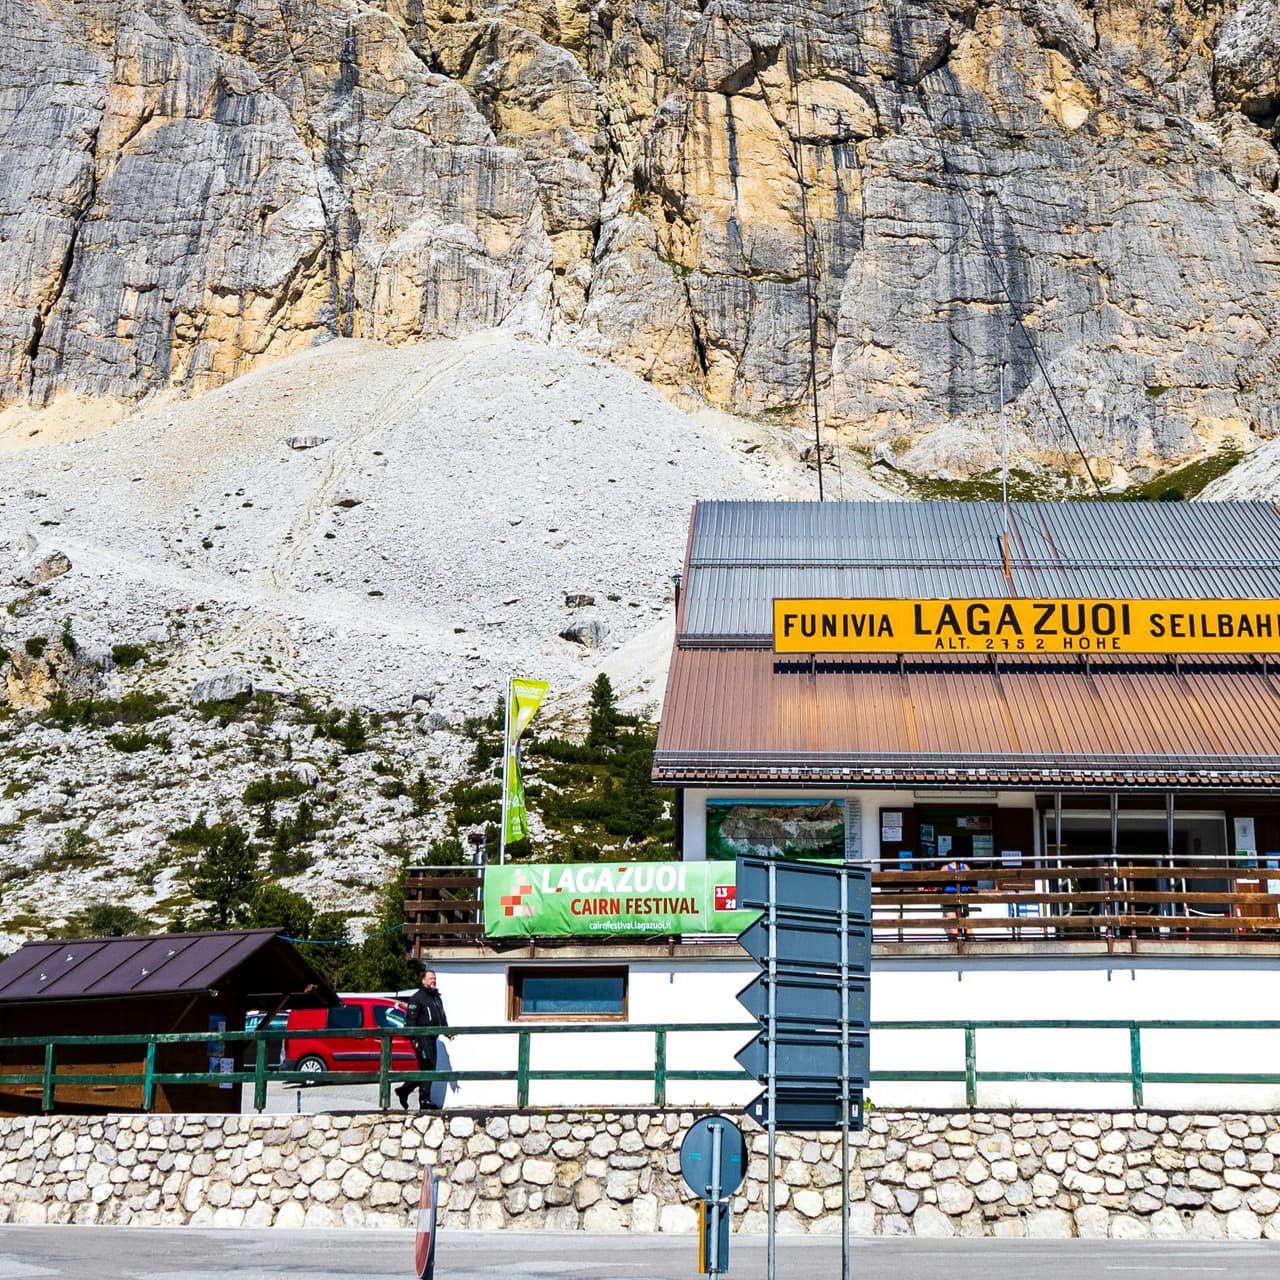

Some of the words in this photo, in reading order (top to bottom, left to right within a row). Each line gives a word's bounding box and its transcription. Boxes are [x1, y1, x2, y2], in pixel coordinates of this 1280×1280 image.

[783, 614, 894, 637] FUNIVIA
[935, 637, 970, 649] ALT.
[1063, 635, 1121, 650] HÖHE
[541, 865, 687, 894] LAGAZUOI
[570, 897, 620, 915] CAIRN
[626, 897, 699, 915] FESTIVAL
[589, 920, 672, 931] cairnfestival.lagazuoi.it
